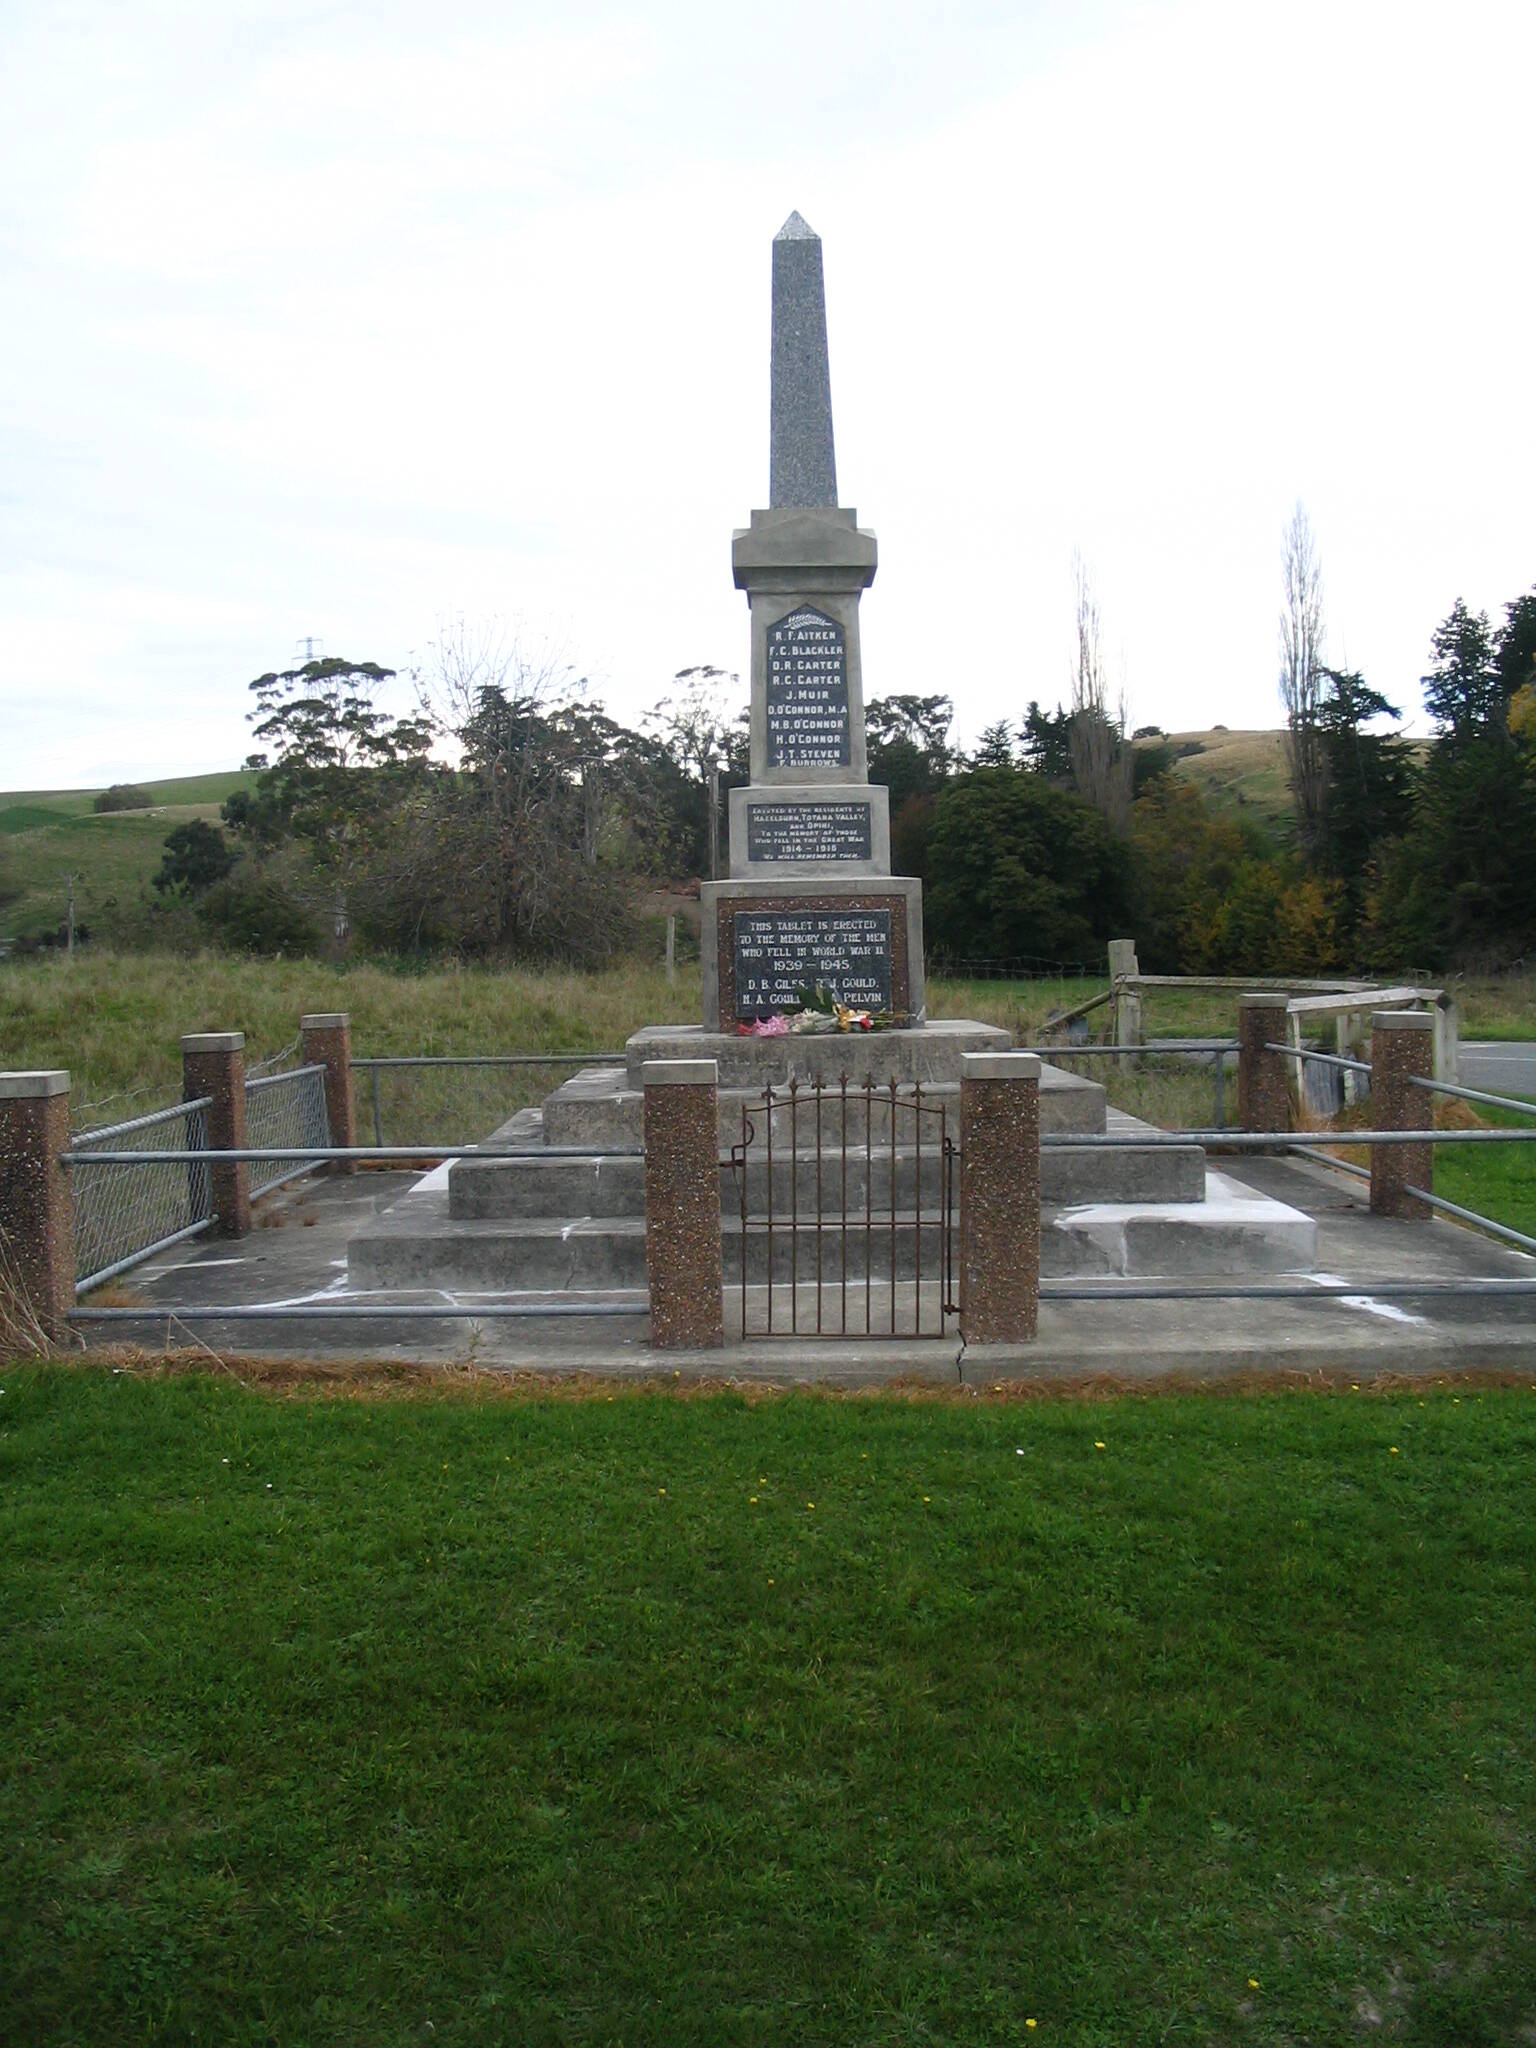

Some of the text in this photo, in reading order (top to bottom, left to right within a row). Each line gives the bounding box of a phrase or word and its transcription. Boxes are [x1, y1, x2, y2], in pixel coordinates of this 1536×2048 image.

[750, 920, 876, 931] THIS TABLET IS ERECTED
[740, 933, 886, 944] TO THE MEMORY OF THE MEN
[742, 946, 884, 958] WHO FELL IN WORLD WAR II
[774, 960, 803, 971] 1939
